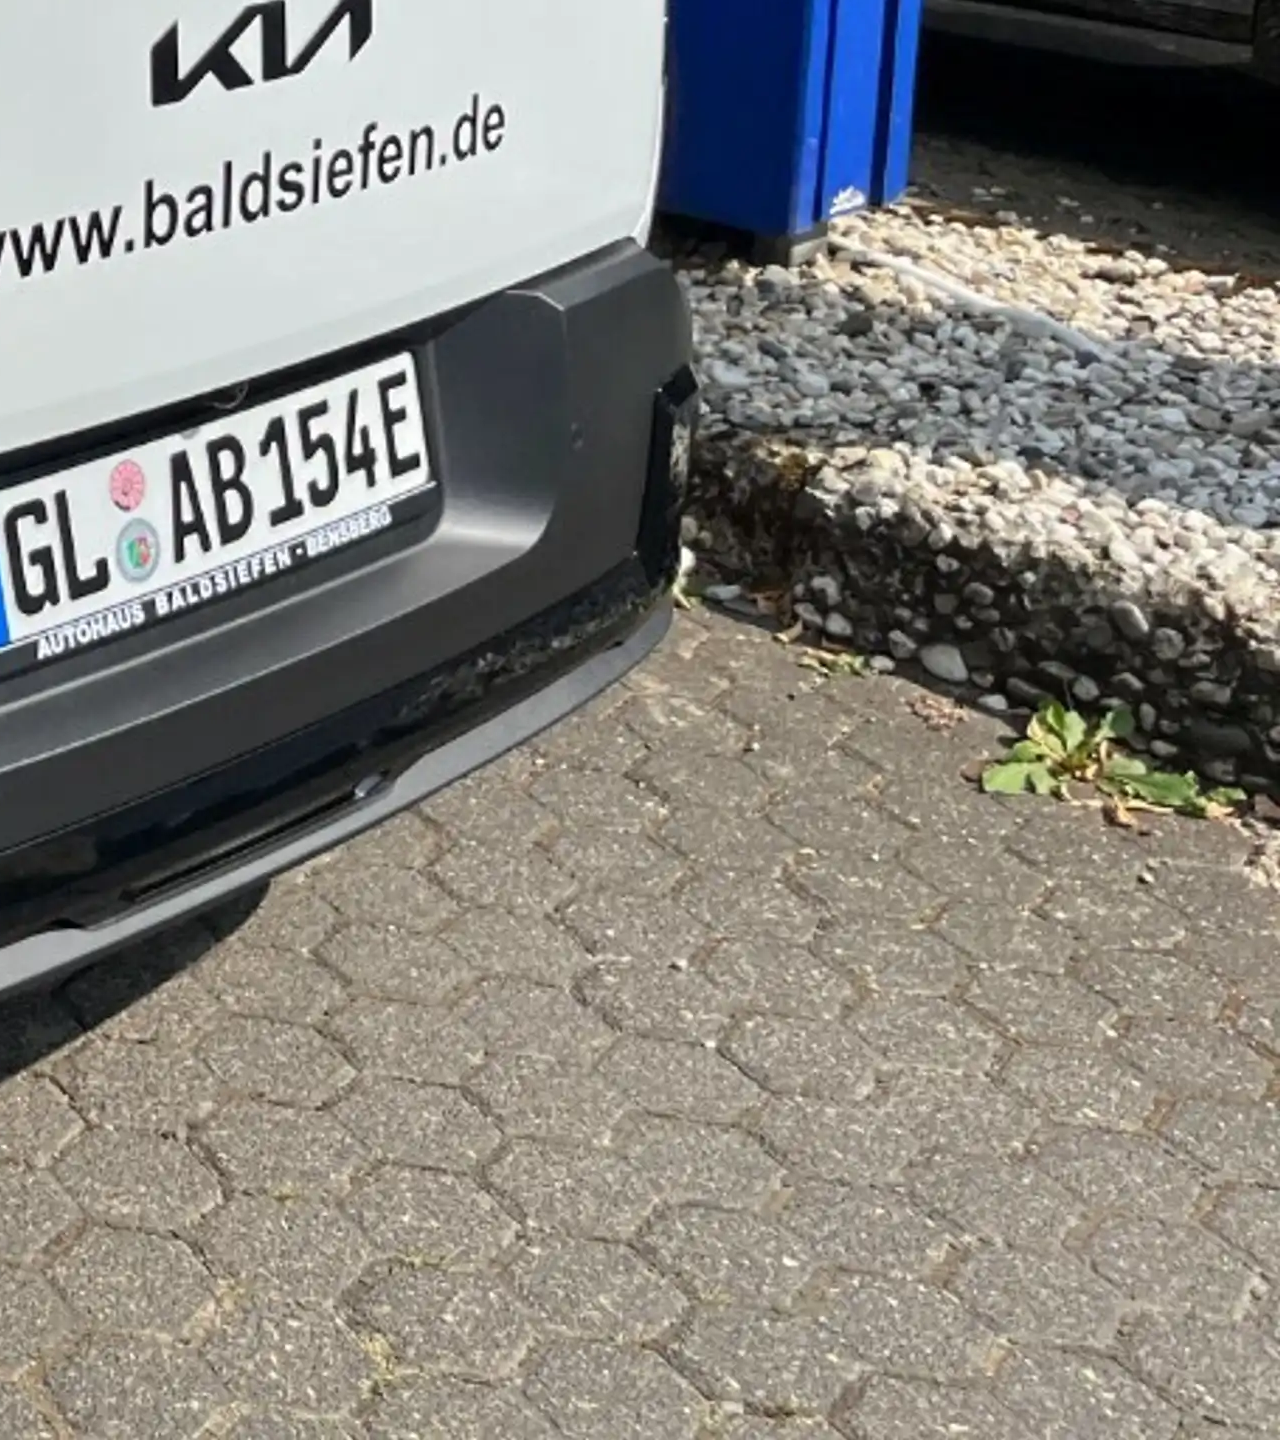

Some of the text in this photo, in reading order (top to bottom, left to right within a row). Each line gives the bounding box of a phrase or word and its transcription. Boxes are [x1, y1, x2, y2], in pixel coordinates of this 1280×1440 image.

[3, 488, 111, 617] GL
[38, 603, 146, 659] AUTOHAUS
[155, 542, 293, 616] BALDSIEFEN
